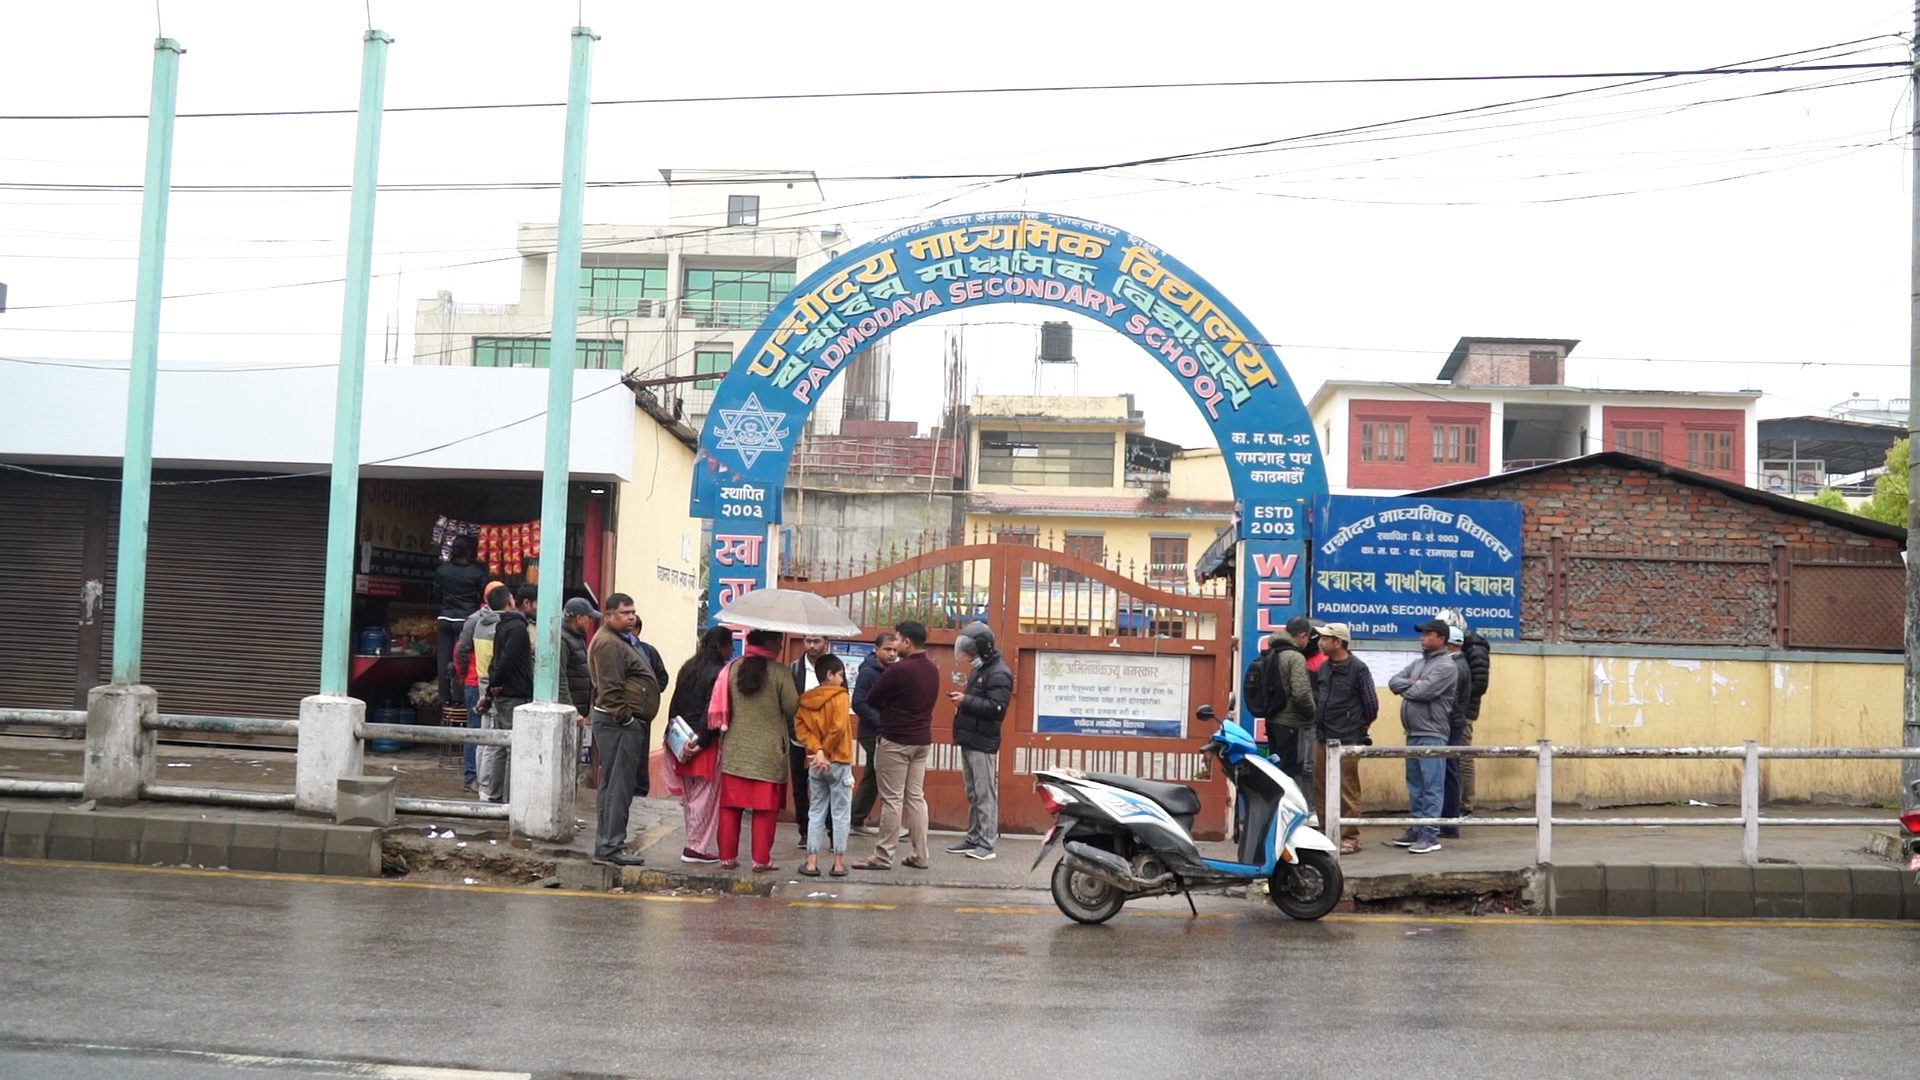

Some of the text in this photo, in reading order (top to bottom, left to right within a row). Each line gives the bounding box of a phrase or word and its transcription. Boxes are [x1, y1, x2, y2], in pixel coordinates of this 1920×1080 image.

[906, 219, 1111, 260] माध्यमिक
[1121, 246, 1278, 388] विद्यालय
[793, 277, 1225, 420] PADMODAYA SECONDARY SCHOOL
[1234, 452, 1312, 468] रामशाह पथ
[720, 484, 765, 501] स्थापित
[721, 504, 763, 517] २००३
[1254, 506, 1294, 519] ESTD
[1250, 522, 1295, 535] 2003
[1378, 504, 1454, 524] माध्यमिक
[1456, 513, 1514, 562] विद्यालय
[1317, 602, 1514, 618] PADMODAYA SECONDY SCHOOL
[1372, 622, 1398, 634] path
